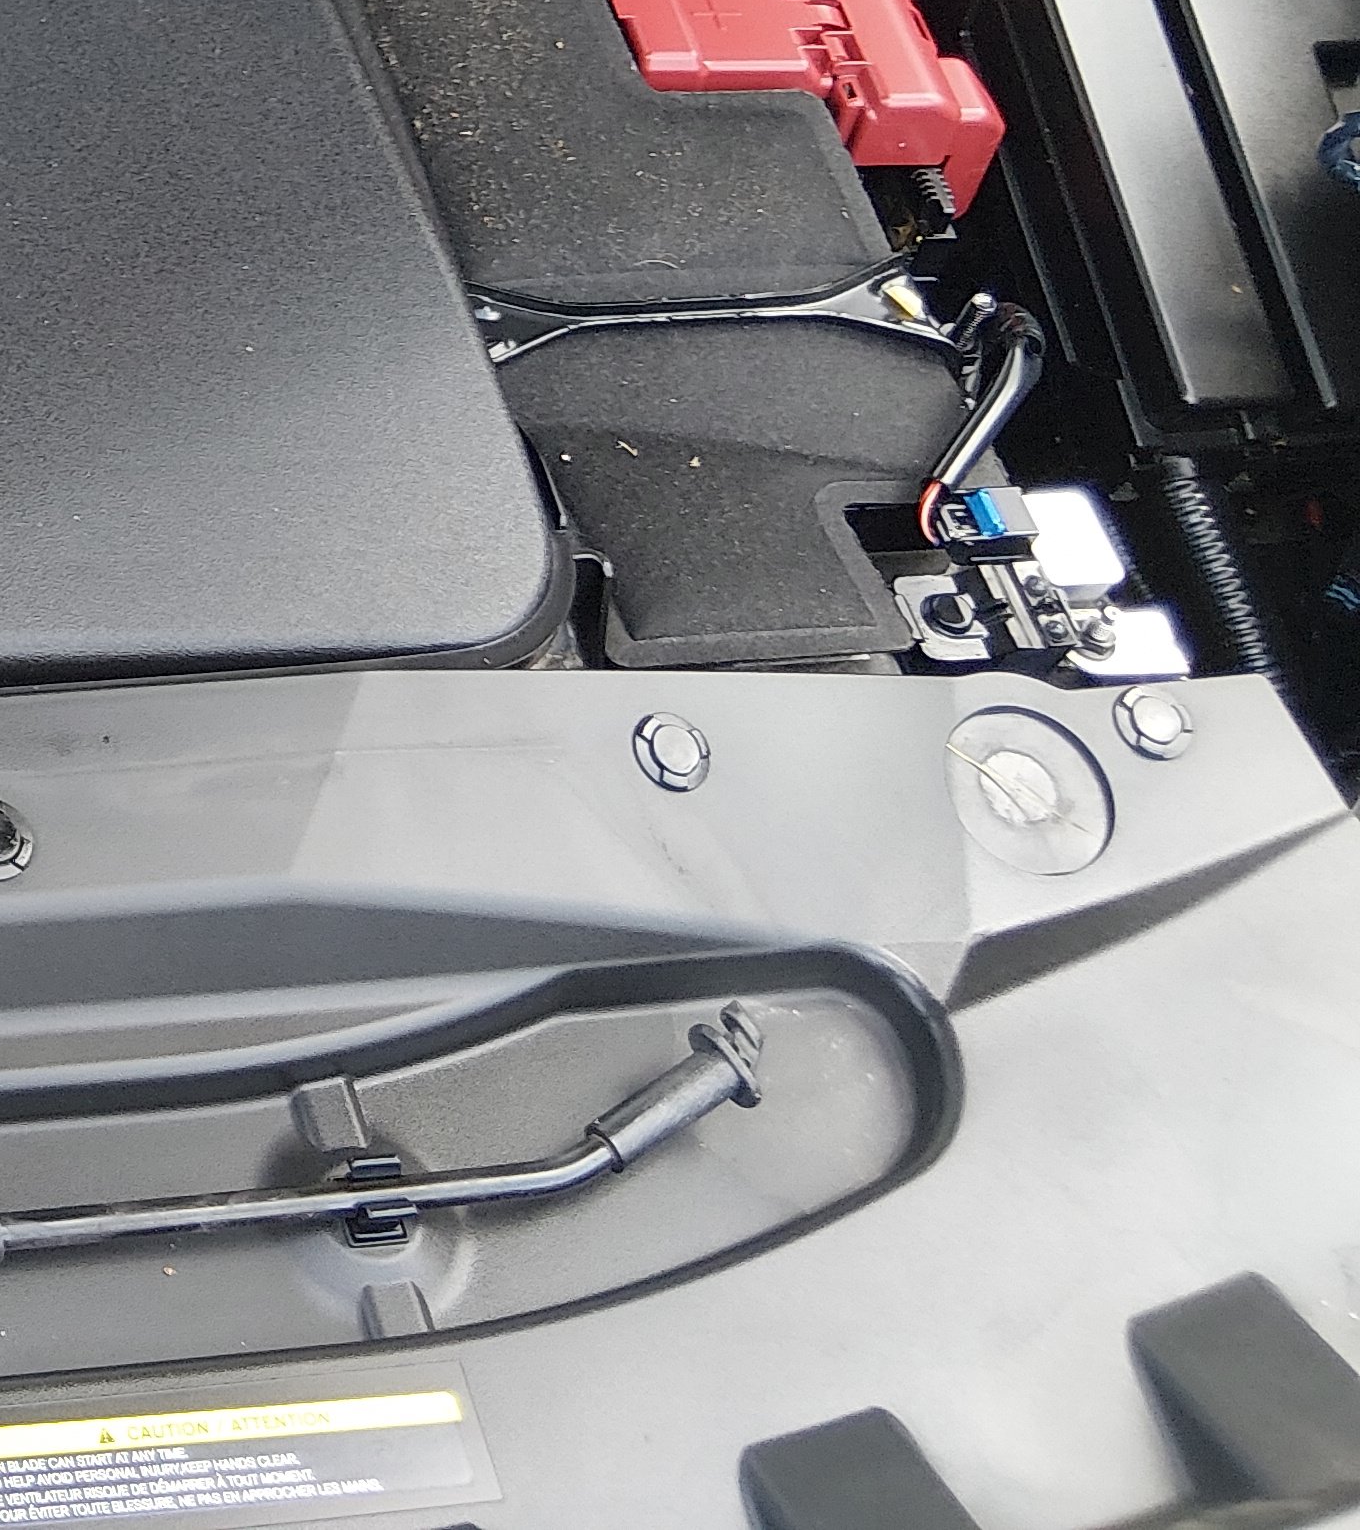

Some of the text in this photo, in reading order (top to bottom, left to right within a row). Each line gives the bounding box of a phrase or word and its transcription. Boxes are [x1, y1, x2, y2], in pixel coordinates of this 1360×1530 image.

[126, 1420, 210, 1441] CAUTION
[231, 1412, 331, 1431] ATTENTION
[3, 1473, 36, 1489] HELP
[35, 1470, 75, 1487] AVOID
[74, 1466, 141, 1485] PERSONAL
[212, 1455, 257, 1473] HANDS
[6, 1457, 47, 1474] BLADE
[47, 1455, 76, 1472] CAN
[76, 1451, 114, 1469] START
[114, 1450, 131, 1465] AT
[131, 1448, 156, 1464] ANY
[6, 1485, 83, 1506] VENTILATEUR
[129, 1481, 149, 1496] DE
[226, 1470, 259, 1488] TOUT
[71, 1498, 113, 1517] TOUTE
[177, 1492, 198, 1508] NE
[197, 1489, 223, 1506] PAS
[222, 1488, 243, 1504] EN
[241, 1483, 317, 1503] APPROCHER
[316, 1480, 342, 1497] LES
